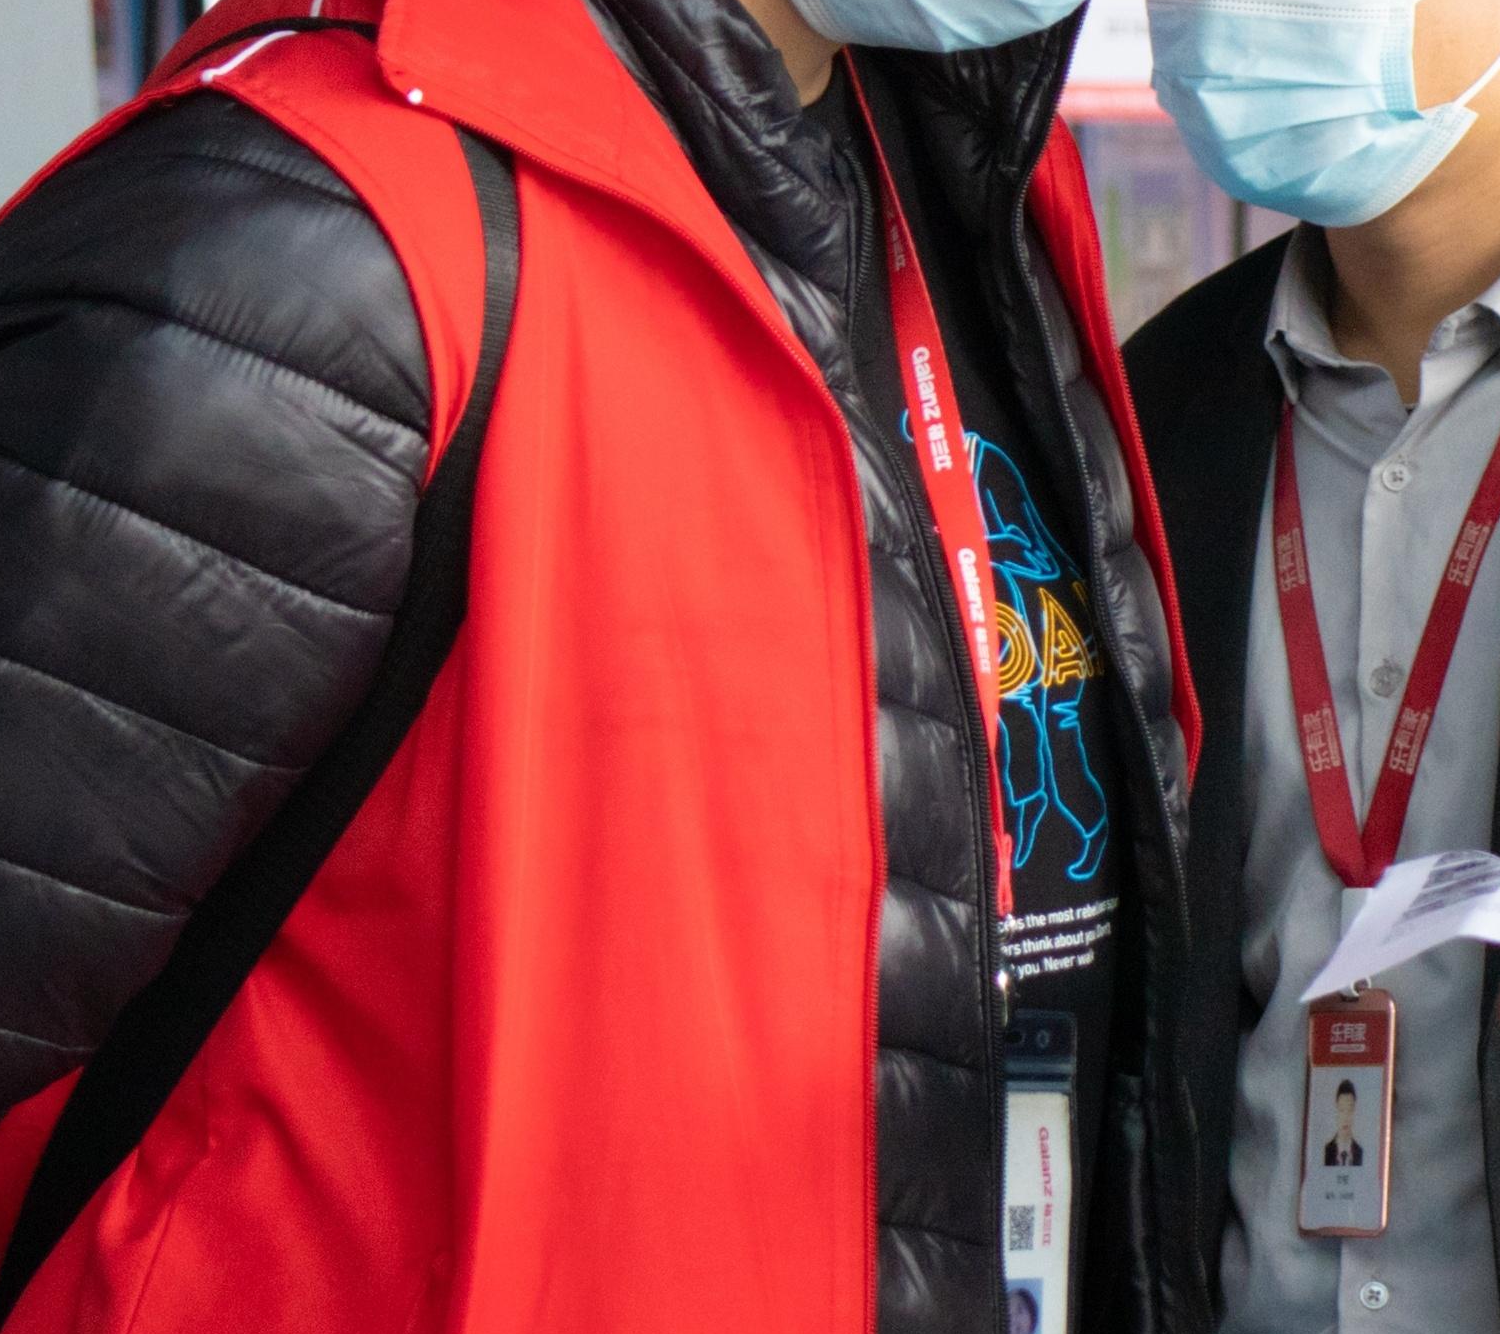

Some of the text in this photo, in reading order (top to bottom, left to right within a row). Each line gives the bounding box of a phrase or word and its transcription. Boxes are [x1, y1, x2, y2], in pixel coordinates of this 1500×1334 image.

[911, 347, 942, 421] Galanz
[1279, 531, 1298, 593] 乐有家
[1448, 521, 1481, 584] 乐有家
[957, 548, 986, 624] Galanz
[1302, 708, 1332, 772] 乐有家
[1389, 707, 1420, 771] 乐有家
[1023, 935, 1053, 954] think
[1055, 930, 1084, 947] about
[1025, 913, 1046, 929] the
[1048, 907, 1074, 924] most
[1018, 962, 1040, 980] you
[1043, 954, 1075, 971] Never
[1038, 1126, 1054, 1197] Galanz
